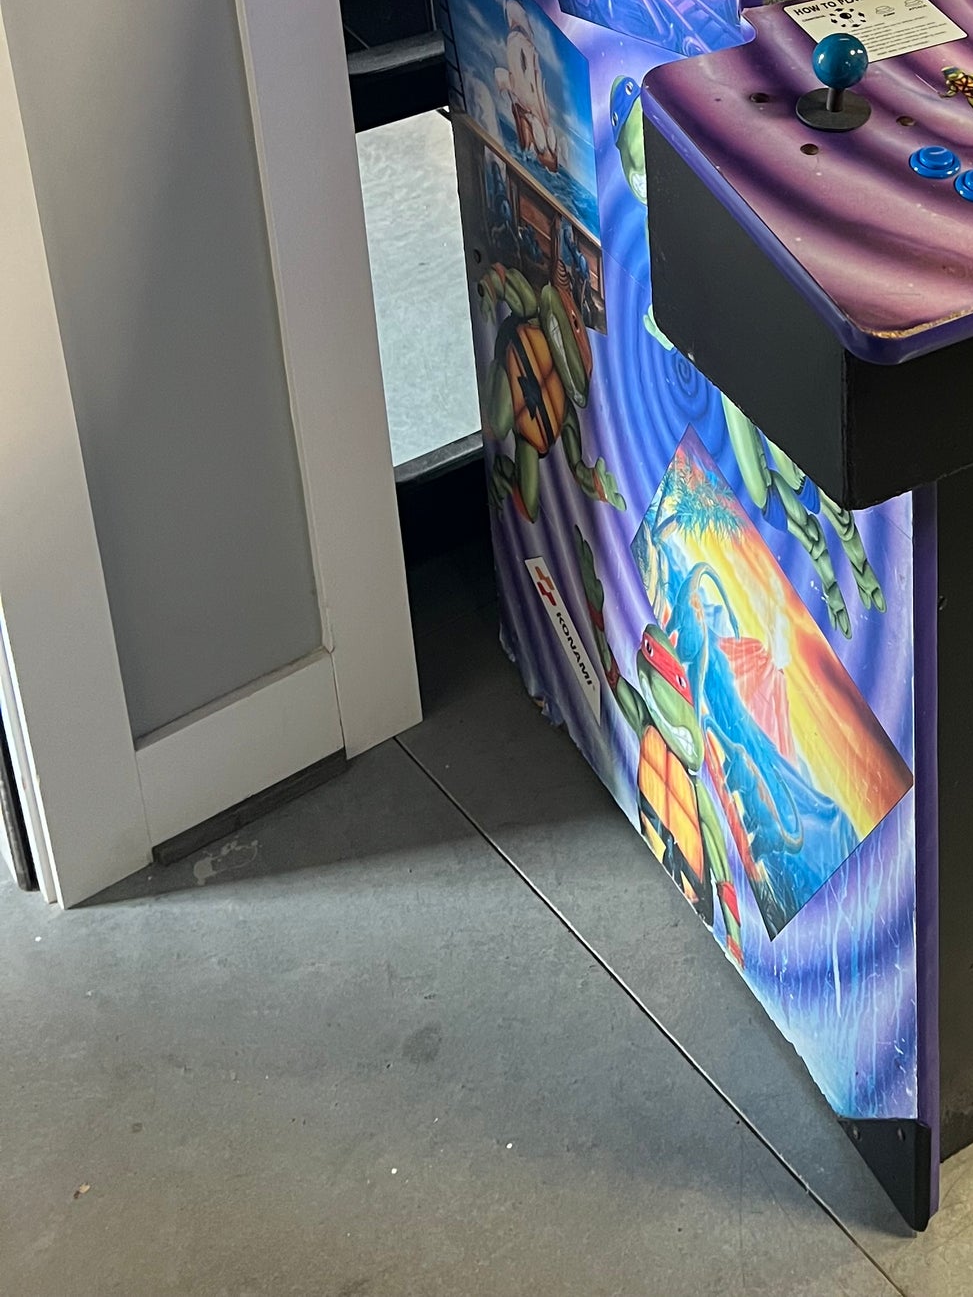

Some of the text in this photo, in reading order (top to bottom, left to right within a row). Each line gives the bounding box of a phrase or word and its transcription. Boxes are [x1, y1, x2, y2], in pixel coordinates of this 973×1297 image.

[794, 6, 821, 16] HOW
[822, 0, 837, 10] TO
[556, 612, 593, 686] KONAMI
